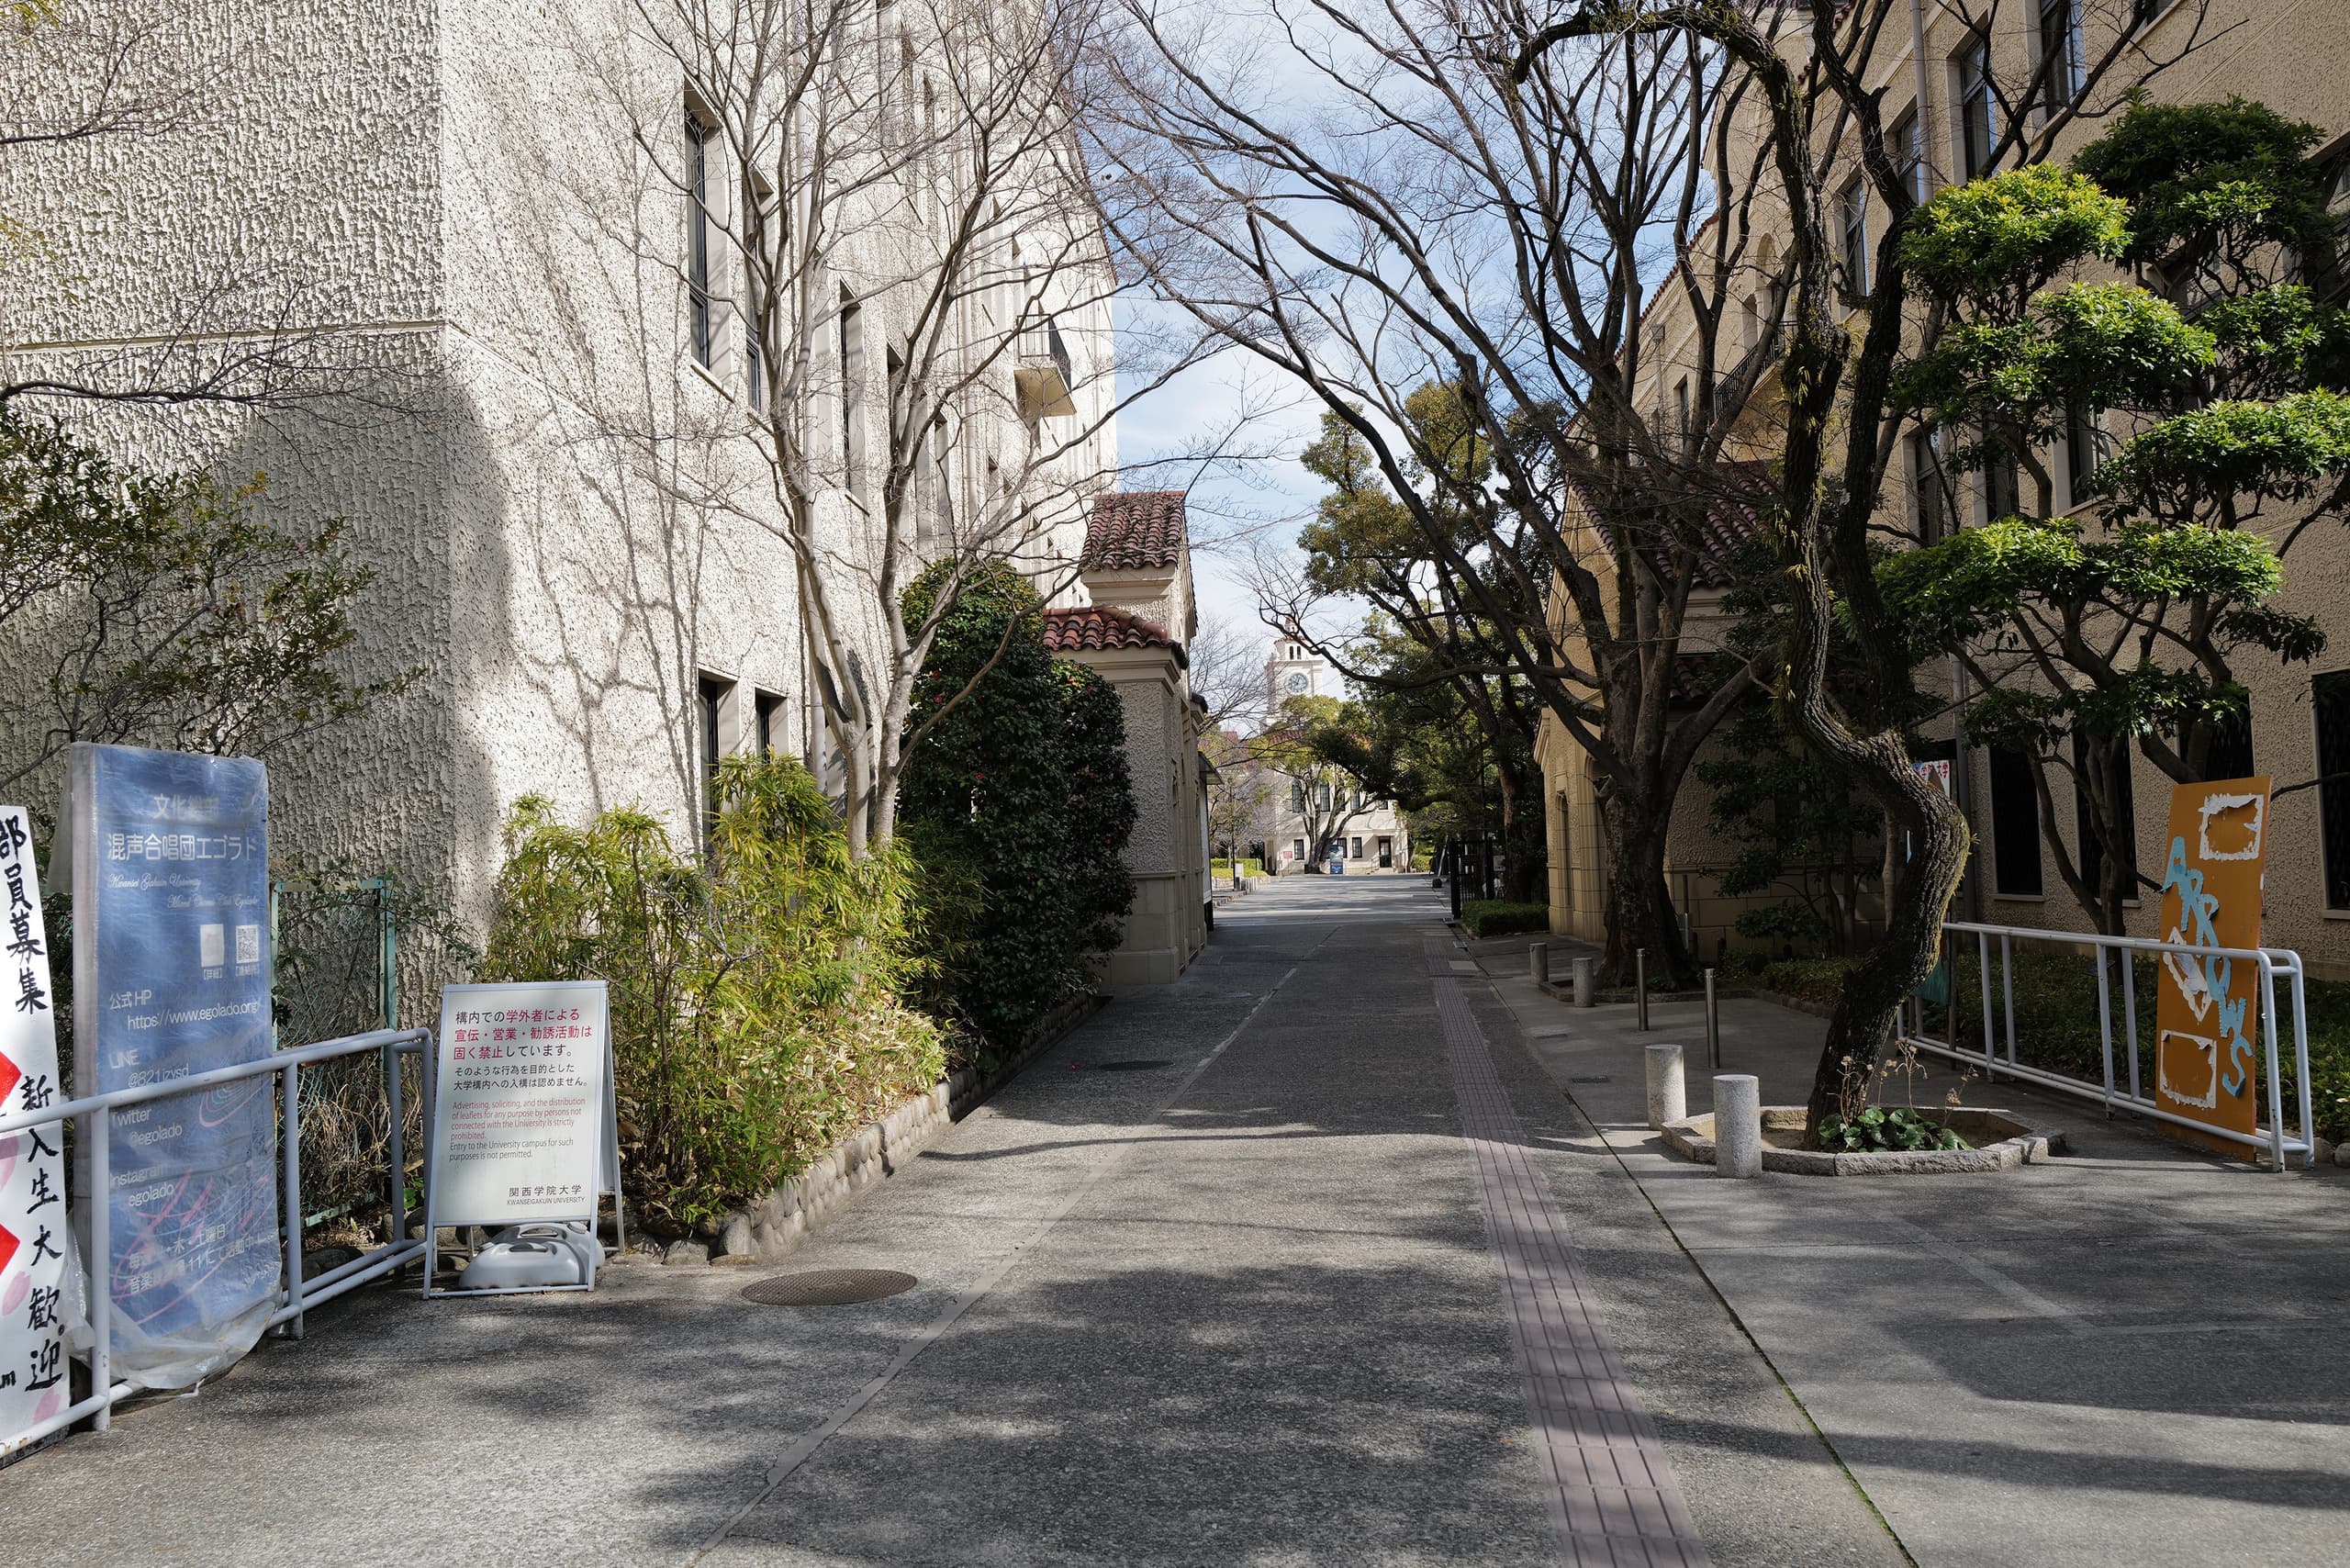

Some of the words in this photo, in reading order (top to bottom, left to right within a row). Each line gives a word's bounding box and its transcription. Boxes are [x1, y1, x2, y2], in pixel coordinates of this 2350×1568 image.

[107, 833, 257, 861] 混声合唱団エゴラド
[2159, 835, 2253, 1097] ARROWS
[455, 1008, 580, 1025] 構内での学外者による
[454, 1025, 592, 1042] 宣伝・営業・勧誘活動は
[109, 1048, 140, 1069] LINE
[453, 1043, 572, 1060] 固く禁止しています。
[454, 1064, 575, 1076] そのような行為を目的とした
[453, 1077, 588, 1091] 大学構内への入構は認めません。
[492, 1100, 521, 1109] soliciting,
[523, 1098, 535, 1106] and
[537, 1098, 548, 1106] the
[549, 1097, 586, 1106] distribution
[110, 1107, 151, 1128] Twitter
[451, 1112, 459, 1120] of
[460, 1111, 483, 1120] leaflets
[484, 1110, 494, 1119] for
[494, 1111, 507, 1120] any
[507, 1110, 533, 1119] purpose
[535, 1109, 543, 1118] by
[544, 1109, 569, 1117] persons
[451, 1122, 486, 1130] connected
[502, 1120, 513, 1128] the
[515, 1119, 546, 1128] University
[547, 1118, 553, 1126] is
[554, 1117, 574, 1126] strictly
[450, 1131, 487, 1141] prohibited.
[450, 1142, 467, 1151] Entry
[476, 1141, 487, 1149] the
[488, 1139, 520, 1149] University
[521, 1140, 547, 1148] campus
[548, 1138, 557, 1147] for
[558, 1137, 574, 1146] such
[449, 1152, 480, 1162] purposes
[487, 1151, 498, 1159] not
[499, 1149, 532, 1160] permitted.
[109, 1161, 172, 1189] Instagram
[128, 1182, 175, 1207] egolado
[509, 1184, 582, 1197] 関西学院大学
